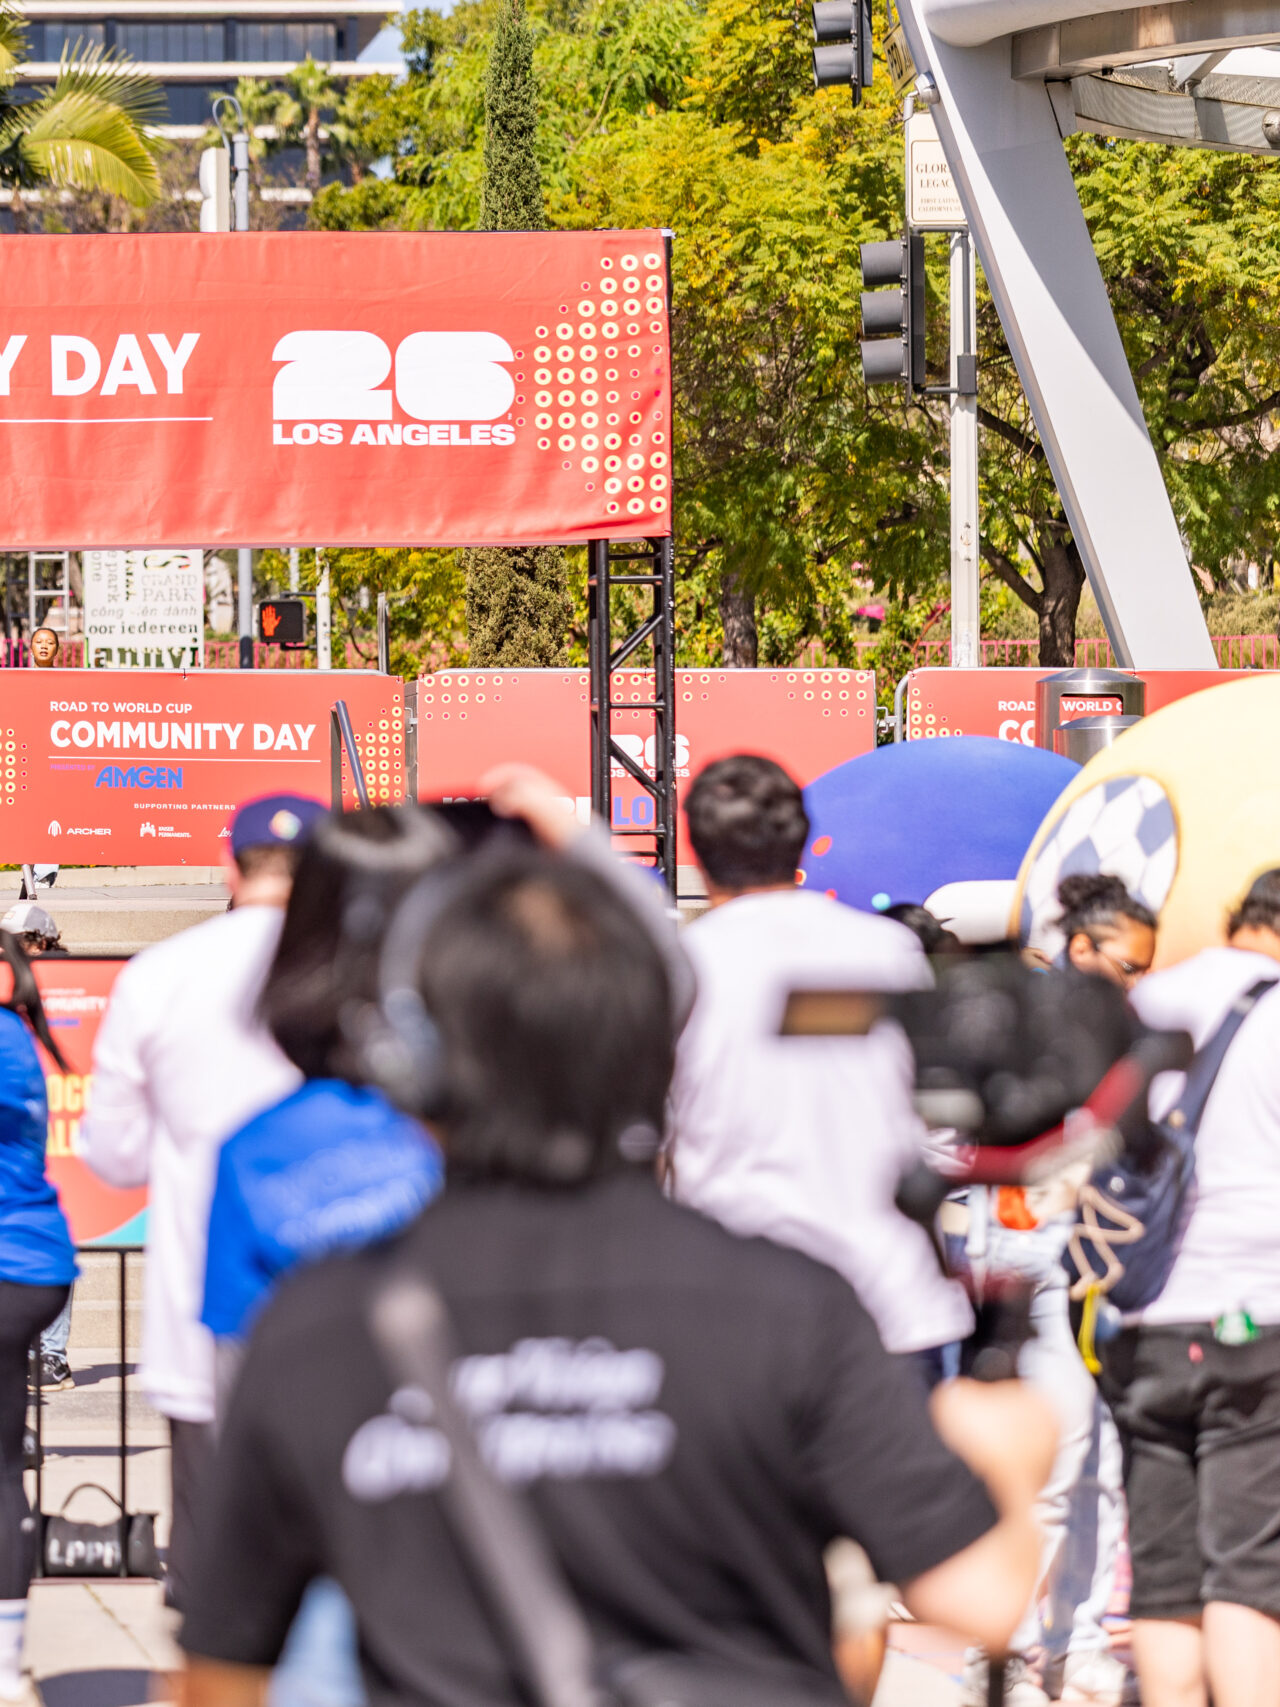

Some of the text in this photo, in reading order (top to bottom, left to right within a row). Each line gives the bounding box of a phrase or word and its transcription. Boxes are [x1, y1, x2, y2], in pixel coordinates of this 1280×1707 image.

[915, 163, 950, 174] GLOR
[920, 179, 952, 188] LEGAC
[50, 332, 201, 396] DAY
[271, 330, 516, 421] 26
[272, 422, 516, 446] LOS ANGELES
[49, 701, 192, 714] ROAD TO WORLD CUP
[998, 700, 1036, 712] ROAD
[1062, 700, 1112, 712] WORLD
[50, 719, 317, 750] COMMUNITY DAY
[94, 766, 183, 789] AMGEN
[133, 802, 236, 811] SUPPORTING PARTNERS
[613, 796, 655, 825] LO
[66, 827, 112, 836] ARCHER
